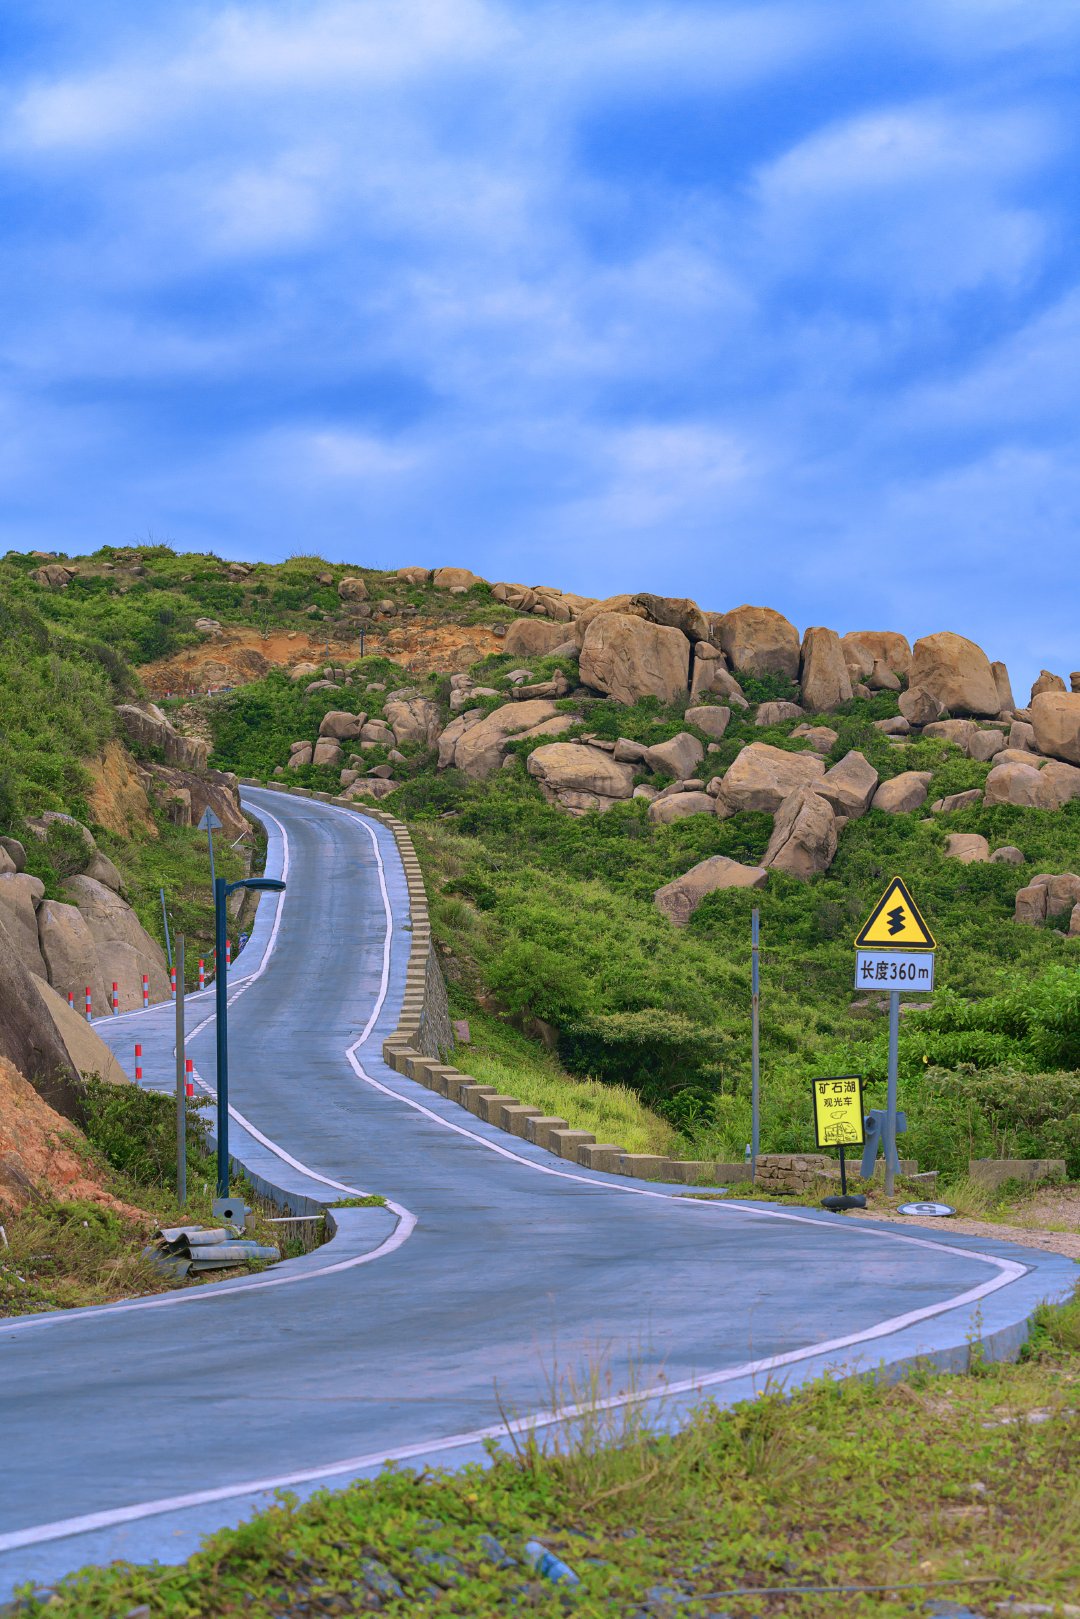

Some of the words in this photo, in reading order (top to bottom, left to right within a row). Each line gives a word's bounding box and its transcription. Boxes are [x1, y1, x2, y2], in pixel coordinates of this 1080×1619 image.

[861, 960, 929, 980] 长度360m
[819, 1081, 856, 1094] 矿石湖
[824, 1097, 853, 1107] 观光车
